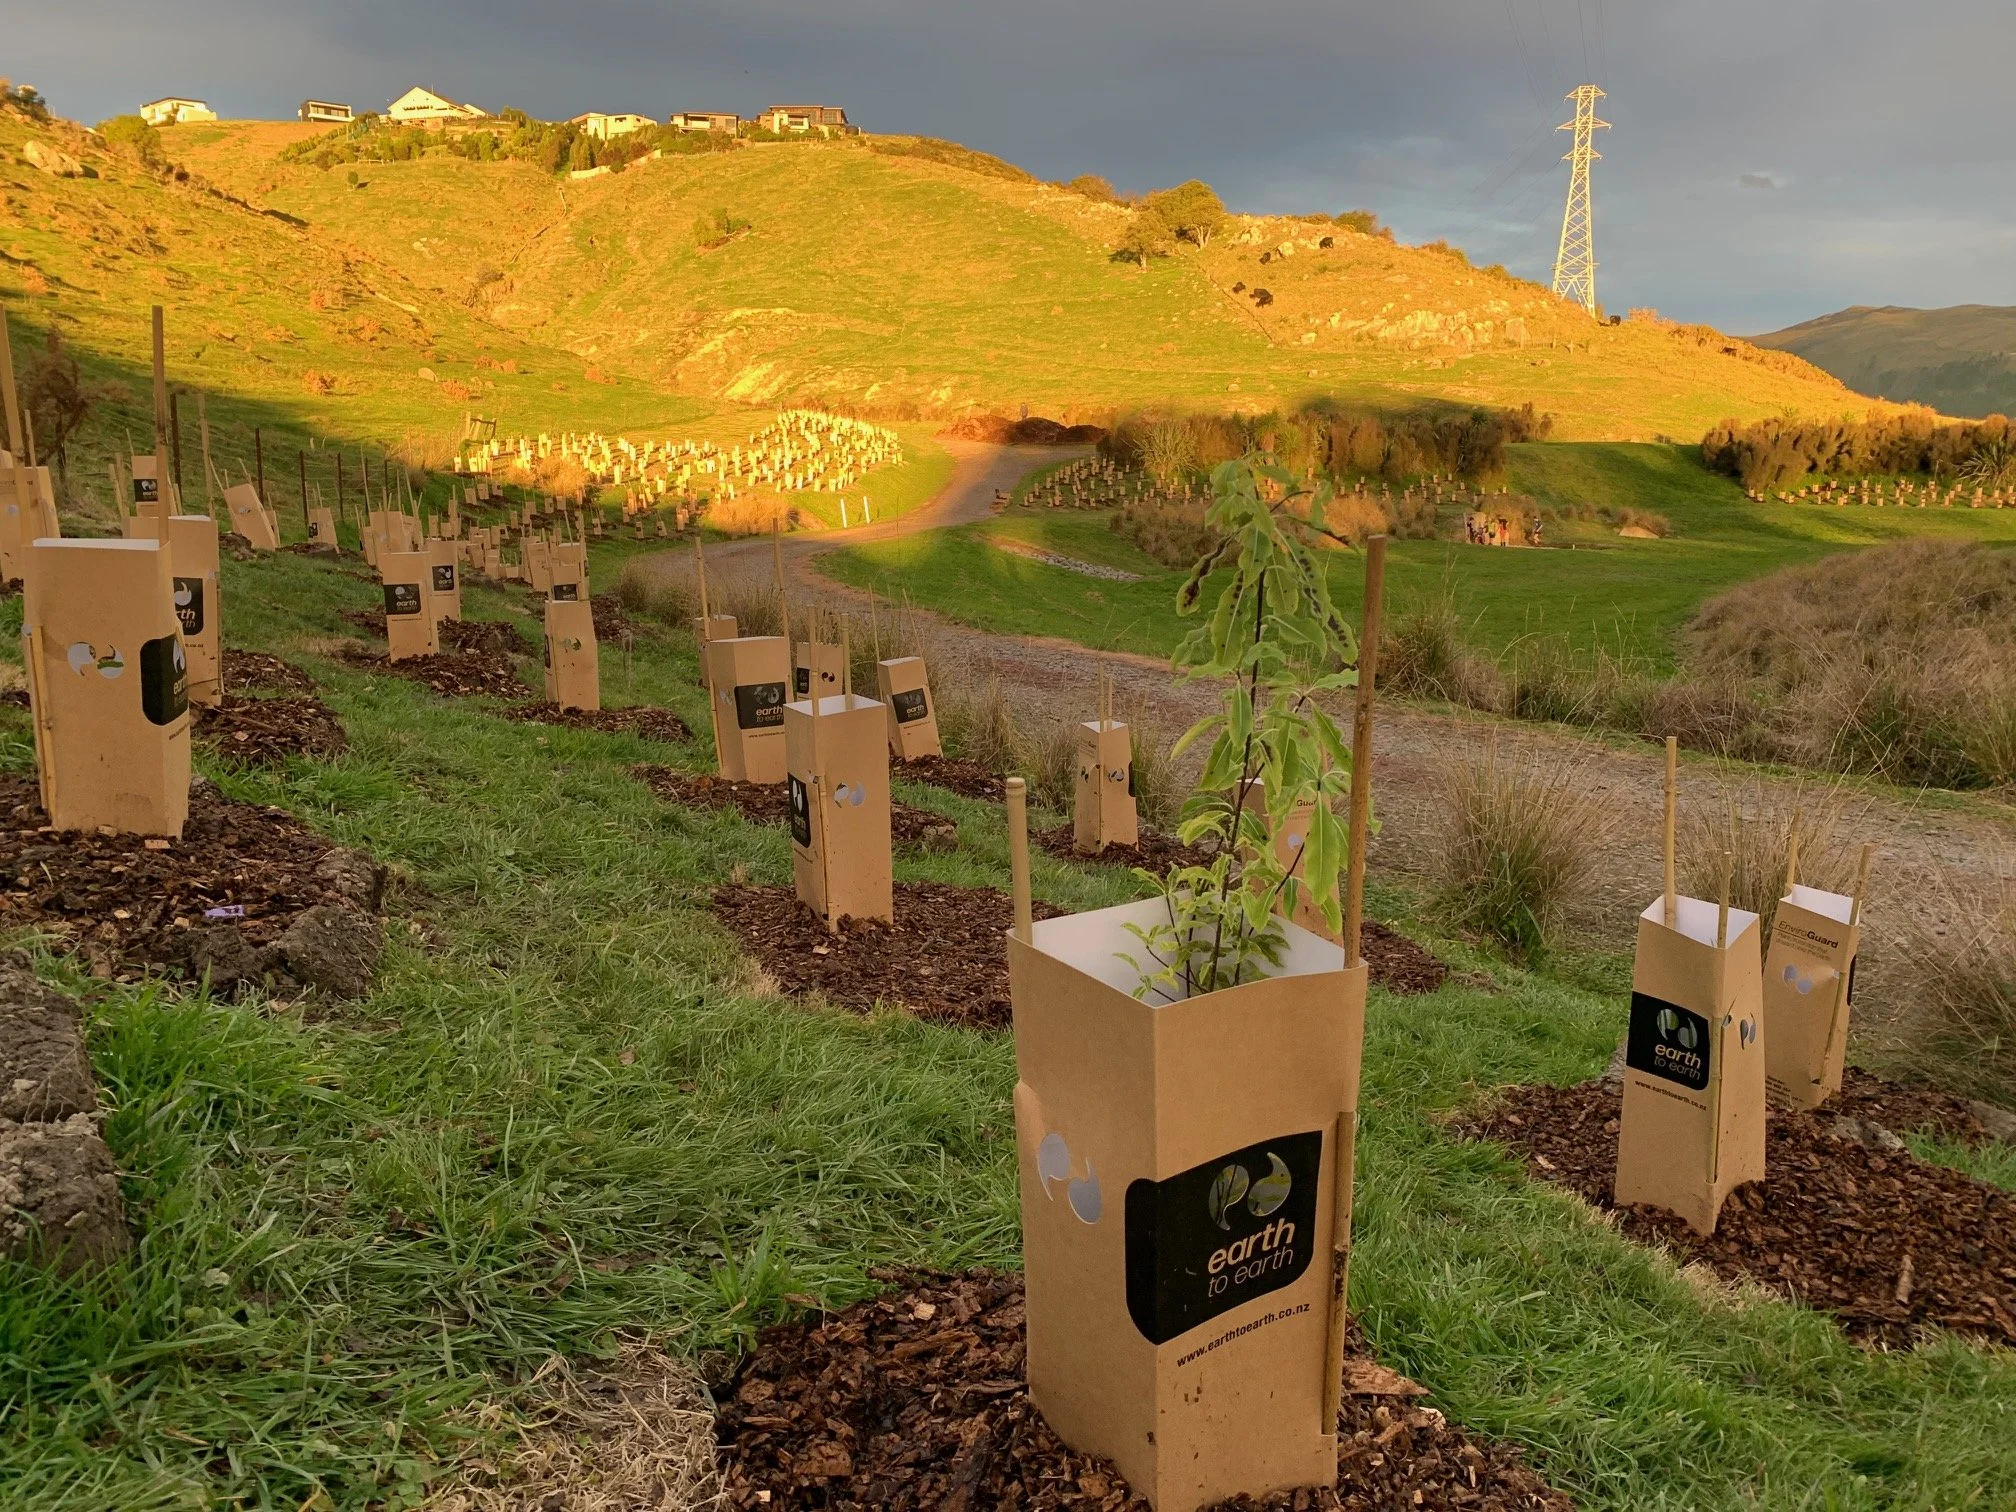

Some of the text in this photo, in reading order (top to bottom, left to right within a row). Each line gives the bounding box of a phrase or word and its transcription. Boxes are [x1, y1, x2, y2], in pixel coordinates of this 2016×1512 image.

[176, 608, 196, 620] rth
[396, 599, 417, 607] earth
[755, 704, 783, 716] earth
[906, 704, 924, 714] earth
[1778, 920, 1839, 949] EnviroGuard
[1654, 1055, 1701, 1080] to earth
[1655, 1044, 1701, 1069] earth
[1208, 1218, 1296, 1274] earth
[1208, 1246, 1294, 1297] to earth
[1176, 1303, 1311, 1368] www.earthtoearth.co.nz
